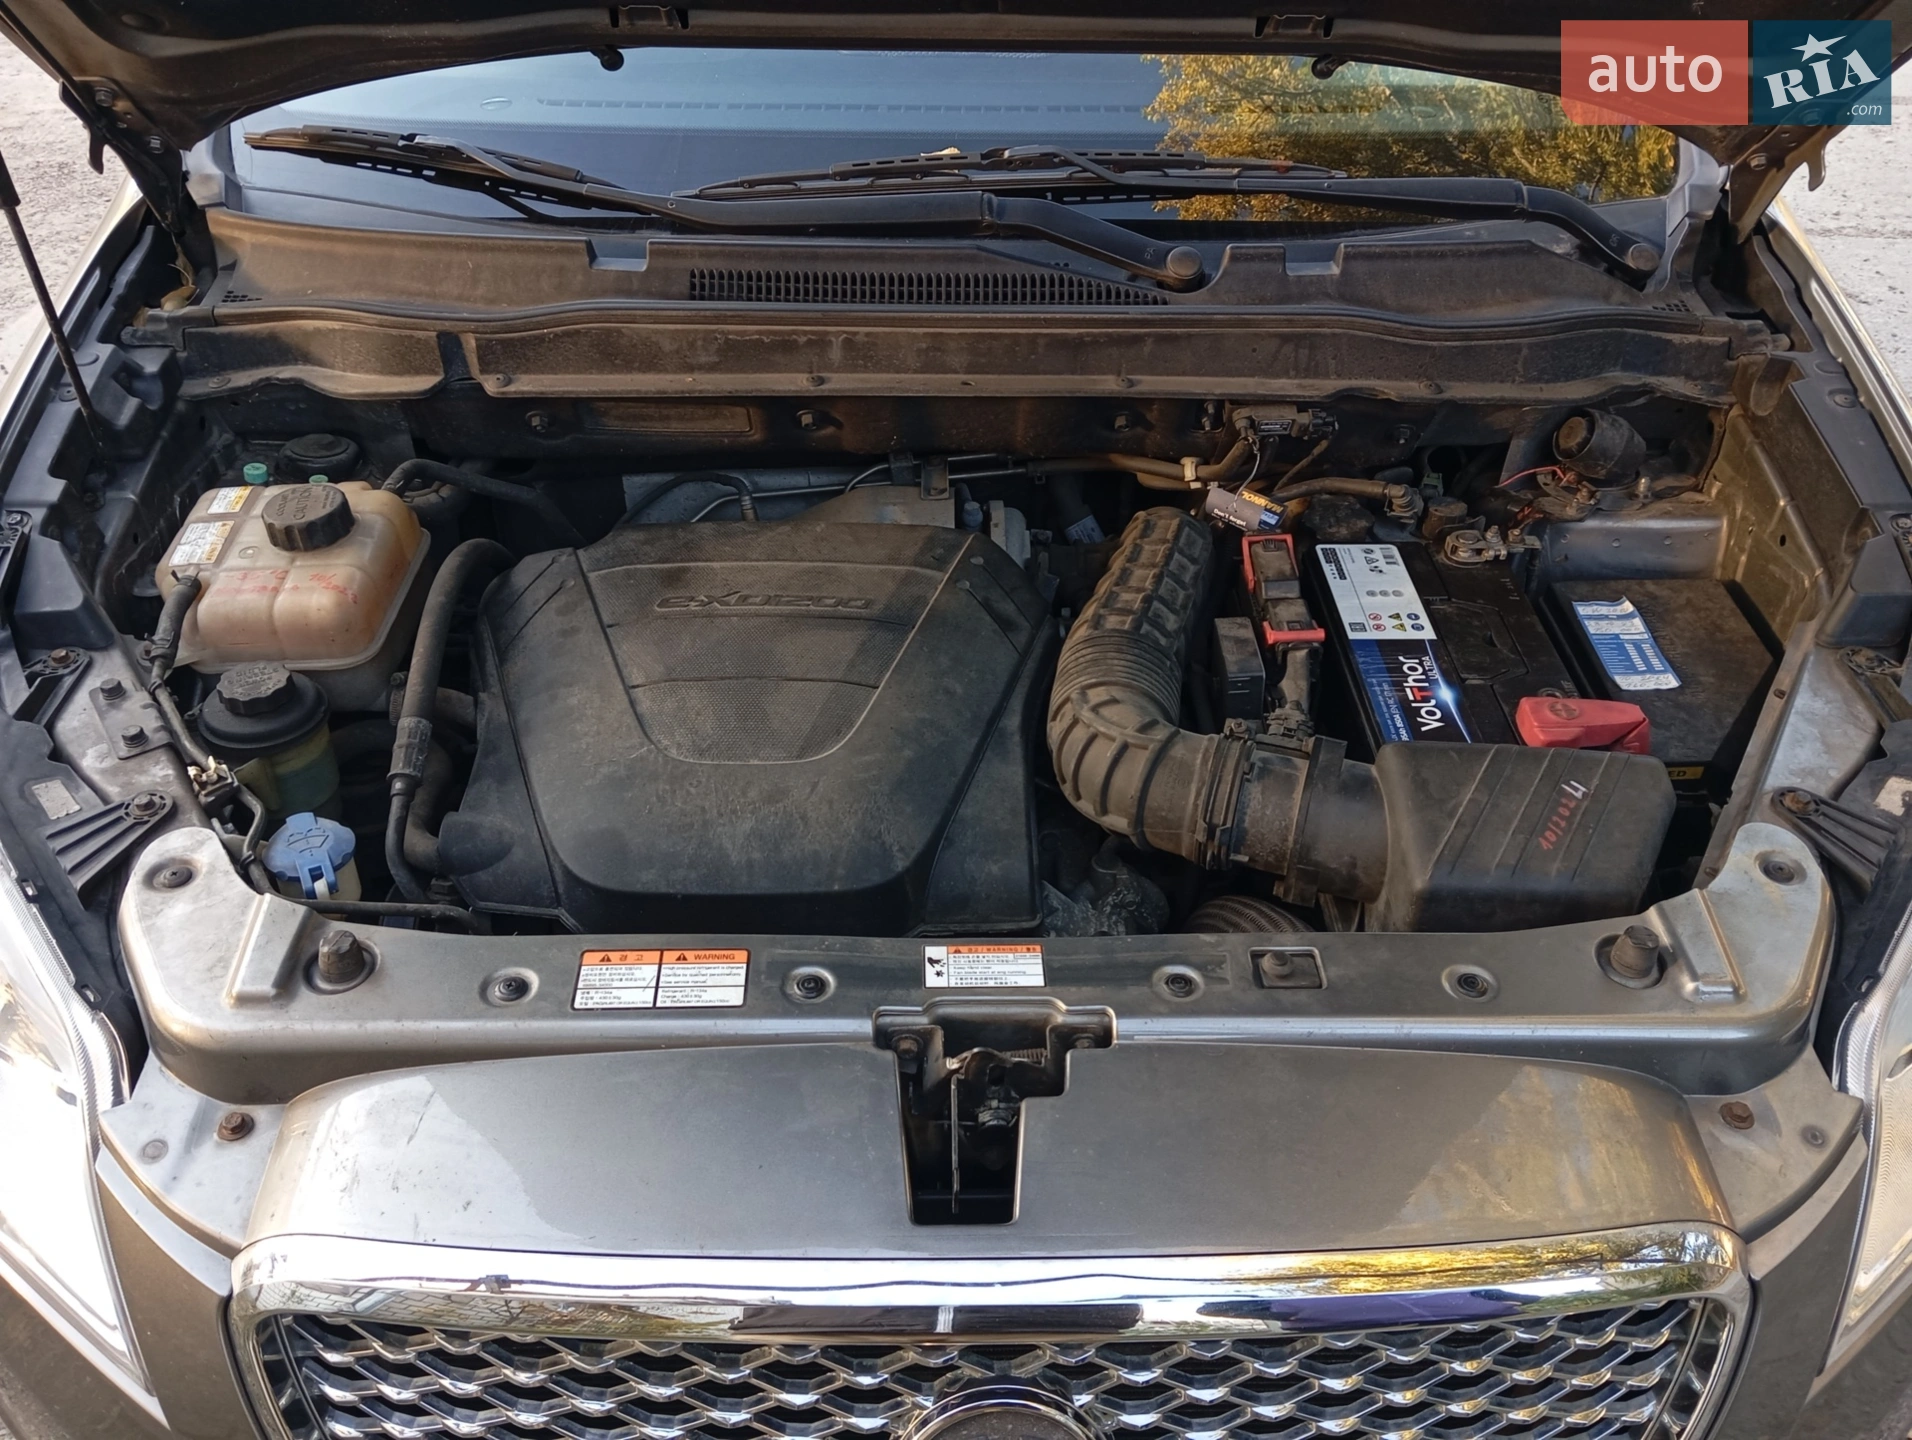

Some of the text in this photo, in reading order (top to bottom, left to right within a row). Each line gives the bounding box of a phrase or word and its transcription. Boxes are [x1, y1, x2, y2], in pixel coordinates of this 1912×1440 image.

[292, 487, 312, 520] CAUTION
[1241, 491, 1284, 514] MANNOL
[1213, 508, 1229, 520] Don't
[1229, 514, 1247, 528] forget
[1421, 655, 1439, 680] ULTRA
[1398, 655, 1446, 732] VolThor
[694, 953, 736, 961] WARNING
